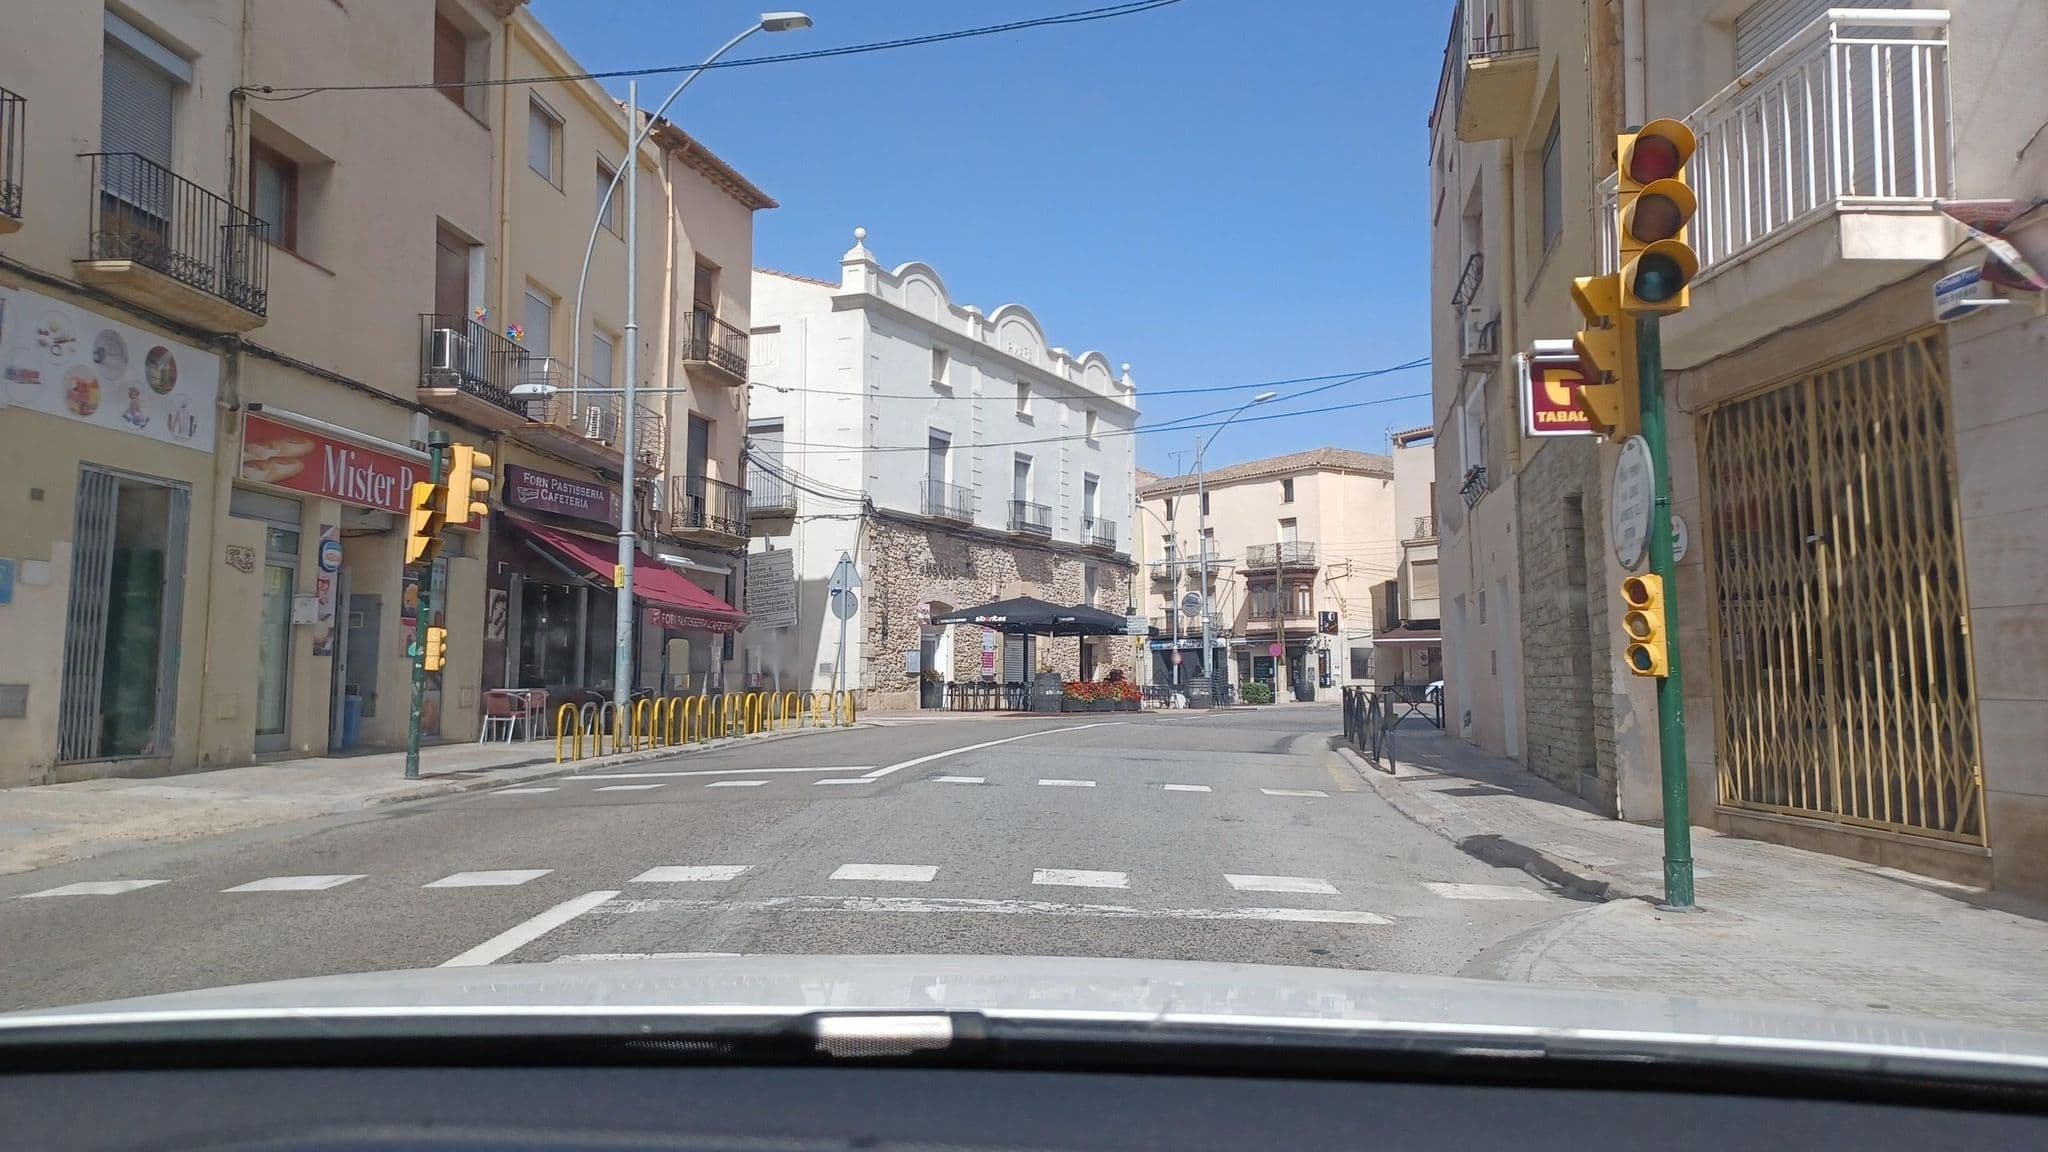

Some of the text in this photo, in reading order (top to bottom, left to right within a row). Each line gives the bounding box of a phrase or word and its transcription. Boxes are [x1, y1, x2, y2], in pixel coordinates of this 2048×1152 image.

[322, 444, 396, 507] Mister
[523, 472, 549, 489] FORN
[551, 478, 604, 501] PASTISSERIA
[541, 488, 589, 509] CAFETERIA
